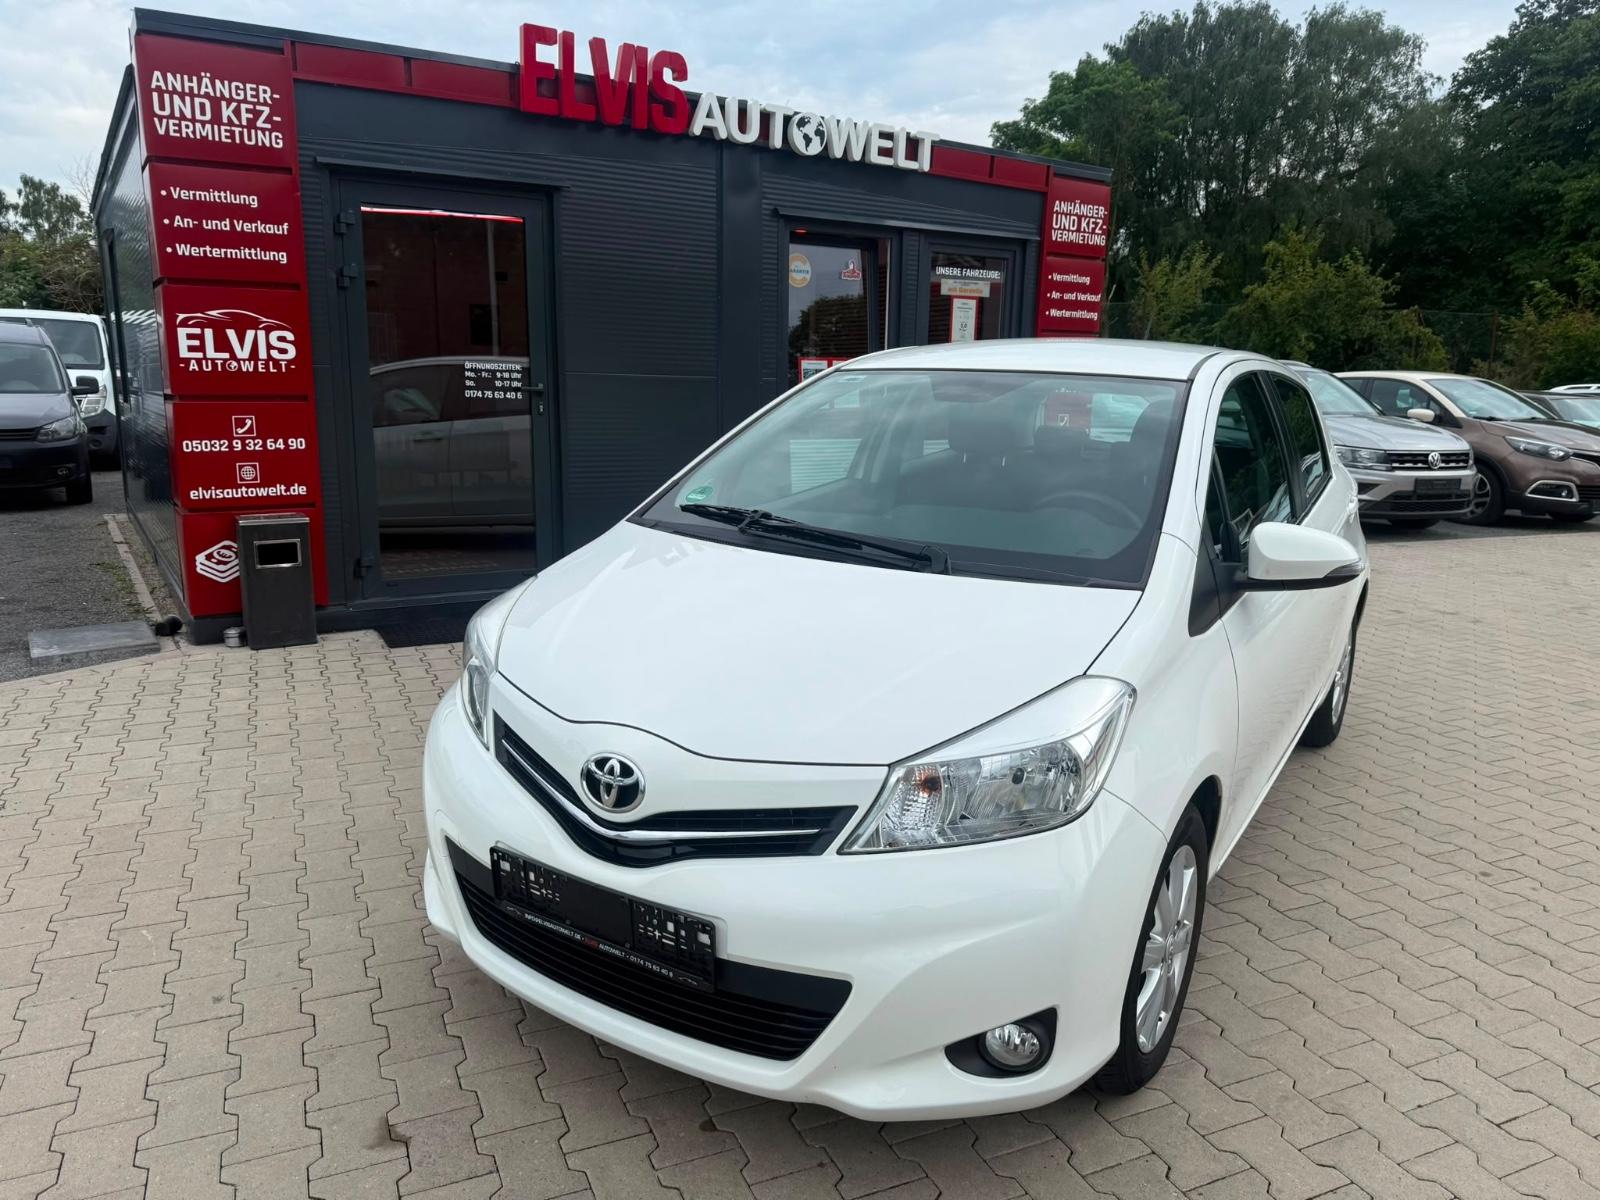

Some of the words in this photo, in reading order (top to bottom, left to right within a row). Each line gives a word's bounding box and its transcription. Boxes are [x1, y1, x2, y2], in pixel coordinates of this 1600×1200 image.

[150, 70, 280, 104] ANHÄNGER-
[520, 22, 689, 135] ELVIS
[152, 92, 212, 121] UND
[221, 103, 282, 129] KFZ-
[154, 118, 284, 148] VERMIETUNG
[170, 186, 258, 208] Vermittlung
[1053, 200, 1108, 218] ANHÄNGER-
[174, 216, 198, 228] An-
[202, 218, 230, 232] und
[234, 220, 288, 235] Verkauf
[1052, 214, 1078, 230] UND
[1081, 217, 1107, 234] KFZ-
[1052, 229, 1106, 247] VERMIETUNG
[176, 244, 288, 264] Wertermittlung
[936, 266, 961, 276] UNSERE
[1053, 273, 1090, 285] Vermittlung
[1052, 291, 1062, 299] An-
[1064, 292, 1076, 300] und
[1077, 293, 1101, 302] Verkauf
[1050, 309, 1098, 320] Wertermittlung
[176, 328, 296, 360] ELVIS
[464, 361, 522, 370] ÖFFNUNGSZEITEN:
[183, 440, 228, 452] 05032
[232, 439, 242, 451] 9
[245, 439, 263, 451] 32
[266, 438, 285, 450] 64
[288, 438, 306, 450] 90
[189, 484, 307, 500] elvisautowelt.de
